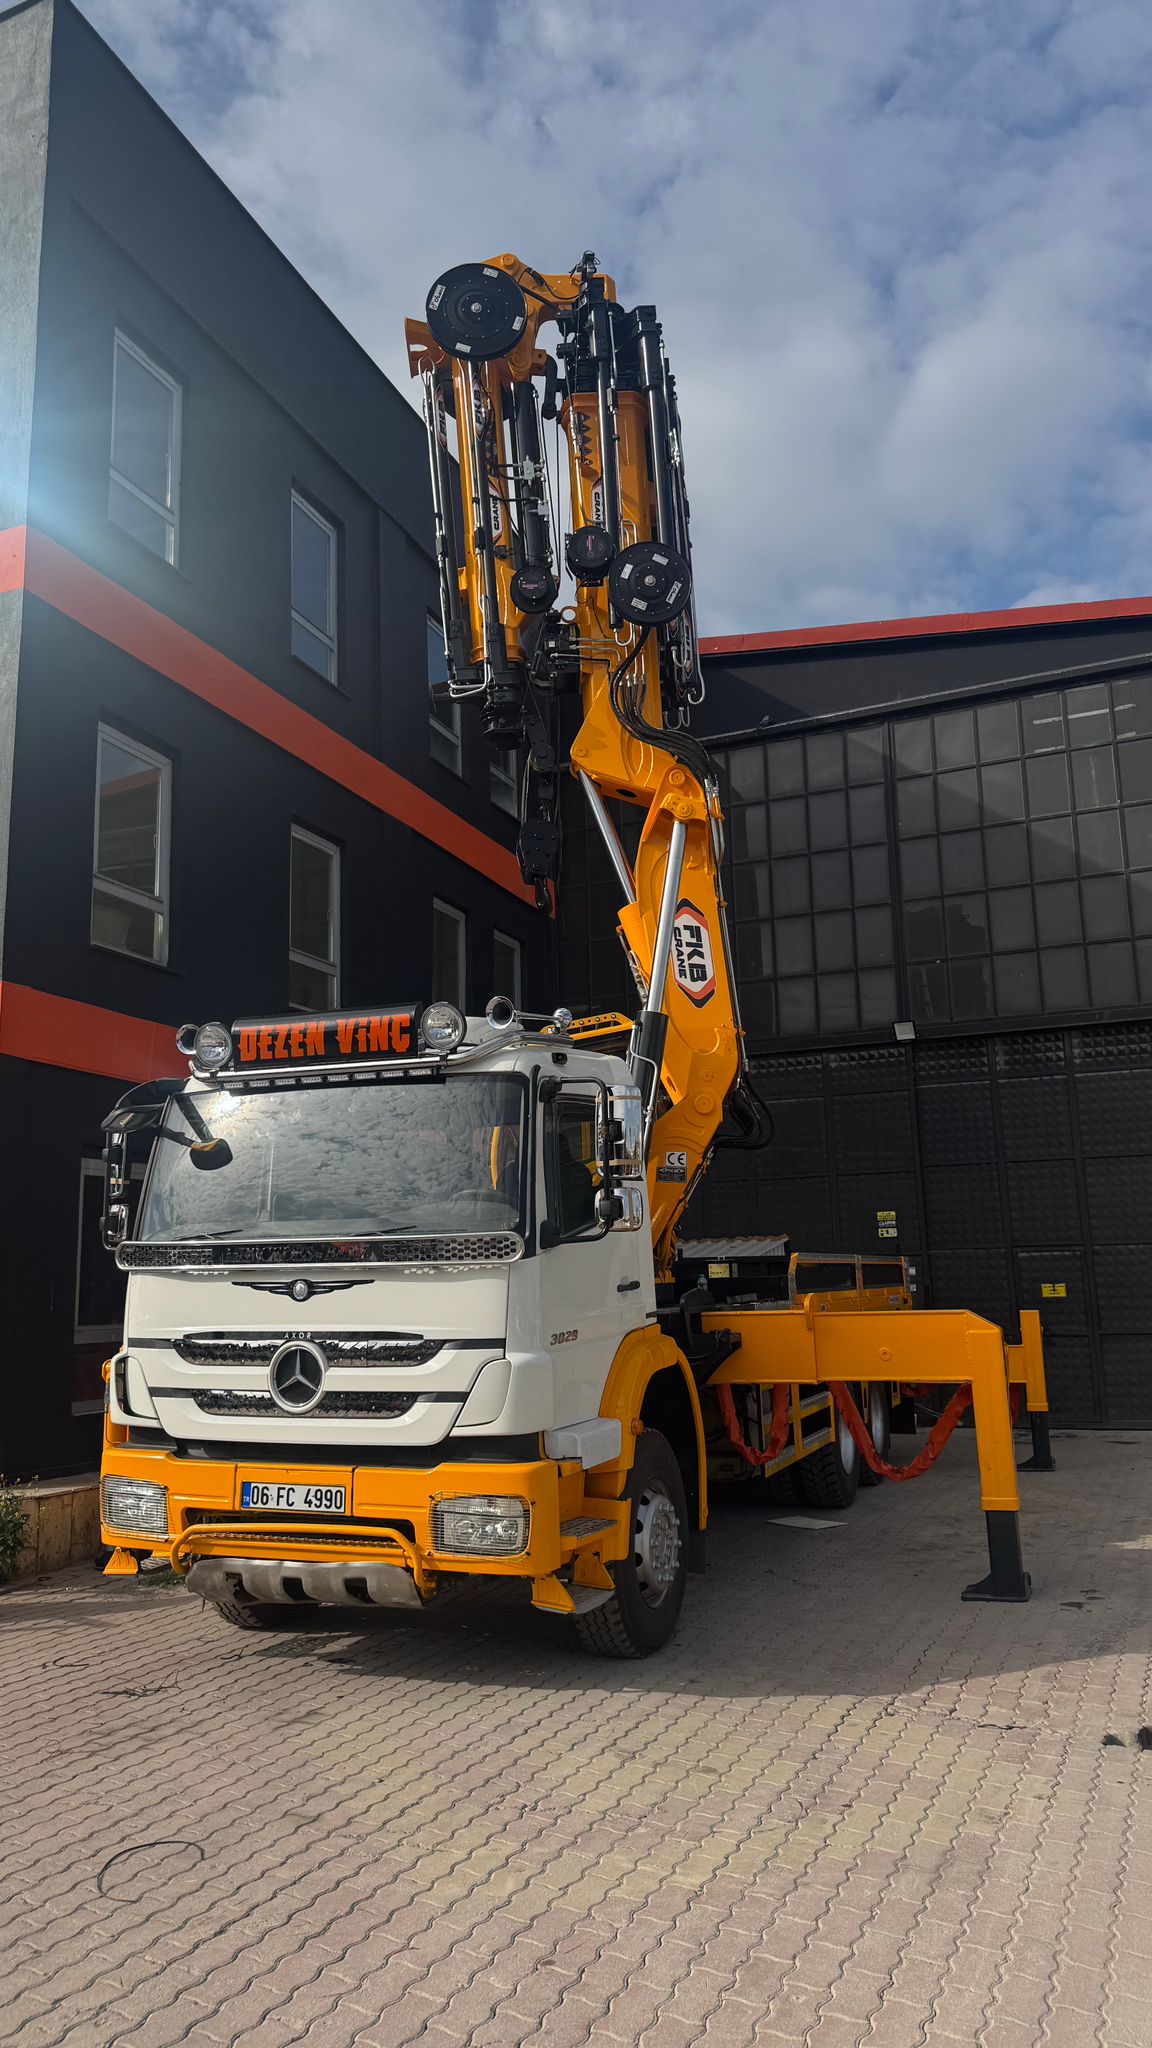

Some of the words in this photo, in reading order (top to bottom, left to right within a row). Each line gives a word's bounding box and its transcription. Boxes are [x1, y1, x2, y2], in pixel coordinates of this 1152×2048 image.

[673, 926, 687, 979] CRANE
[683, 924, 708, 982] FKB
[237, 1021, 326, 1062] DEZEN
[667, 1152, 686, 1165] CE
[284, 1331, 312, 1340] AXOR
[550, 1329, 578, 1345] 3029
[251, 1485, 270, 1505] 06
[276, 1487, 295, 1507] FC
[303, 1488, 343, 1509] 4990
